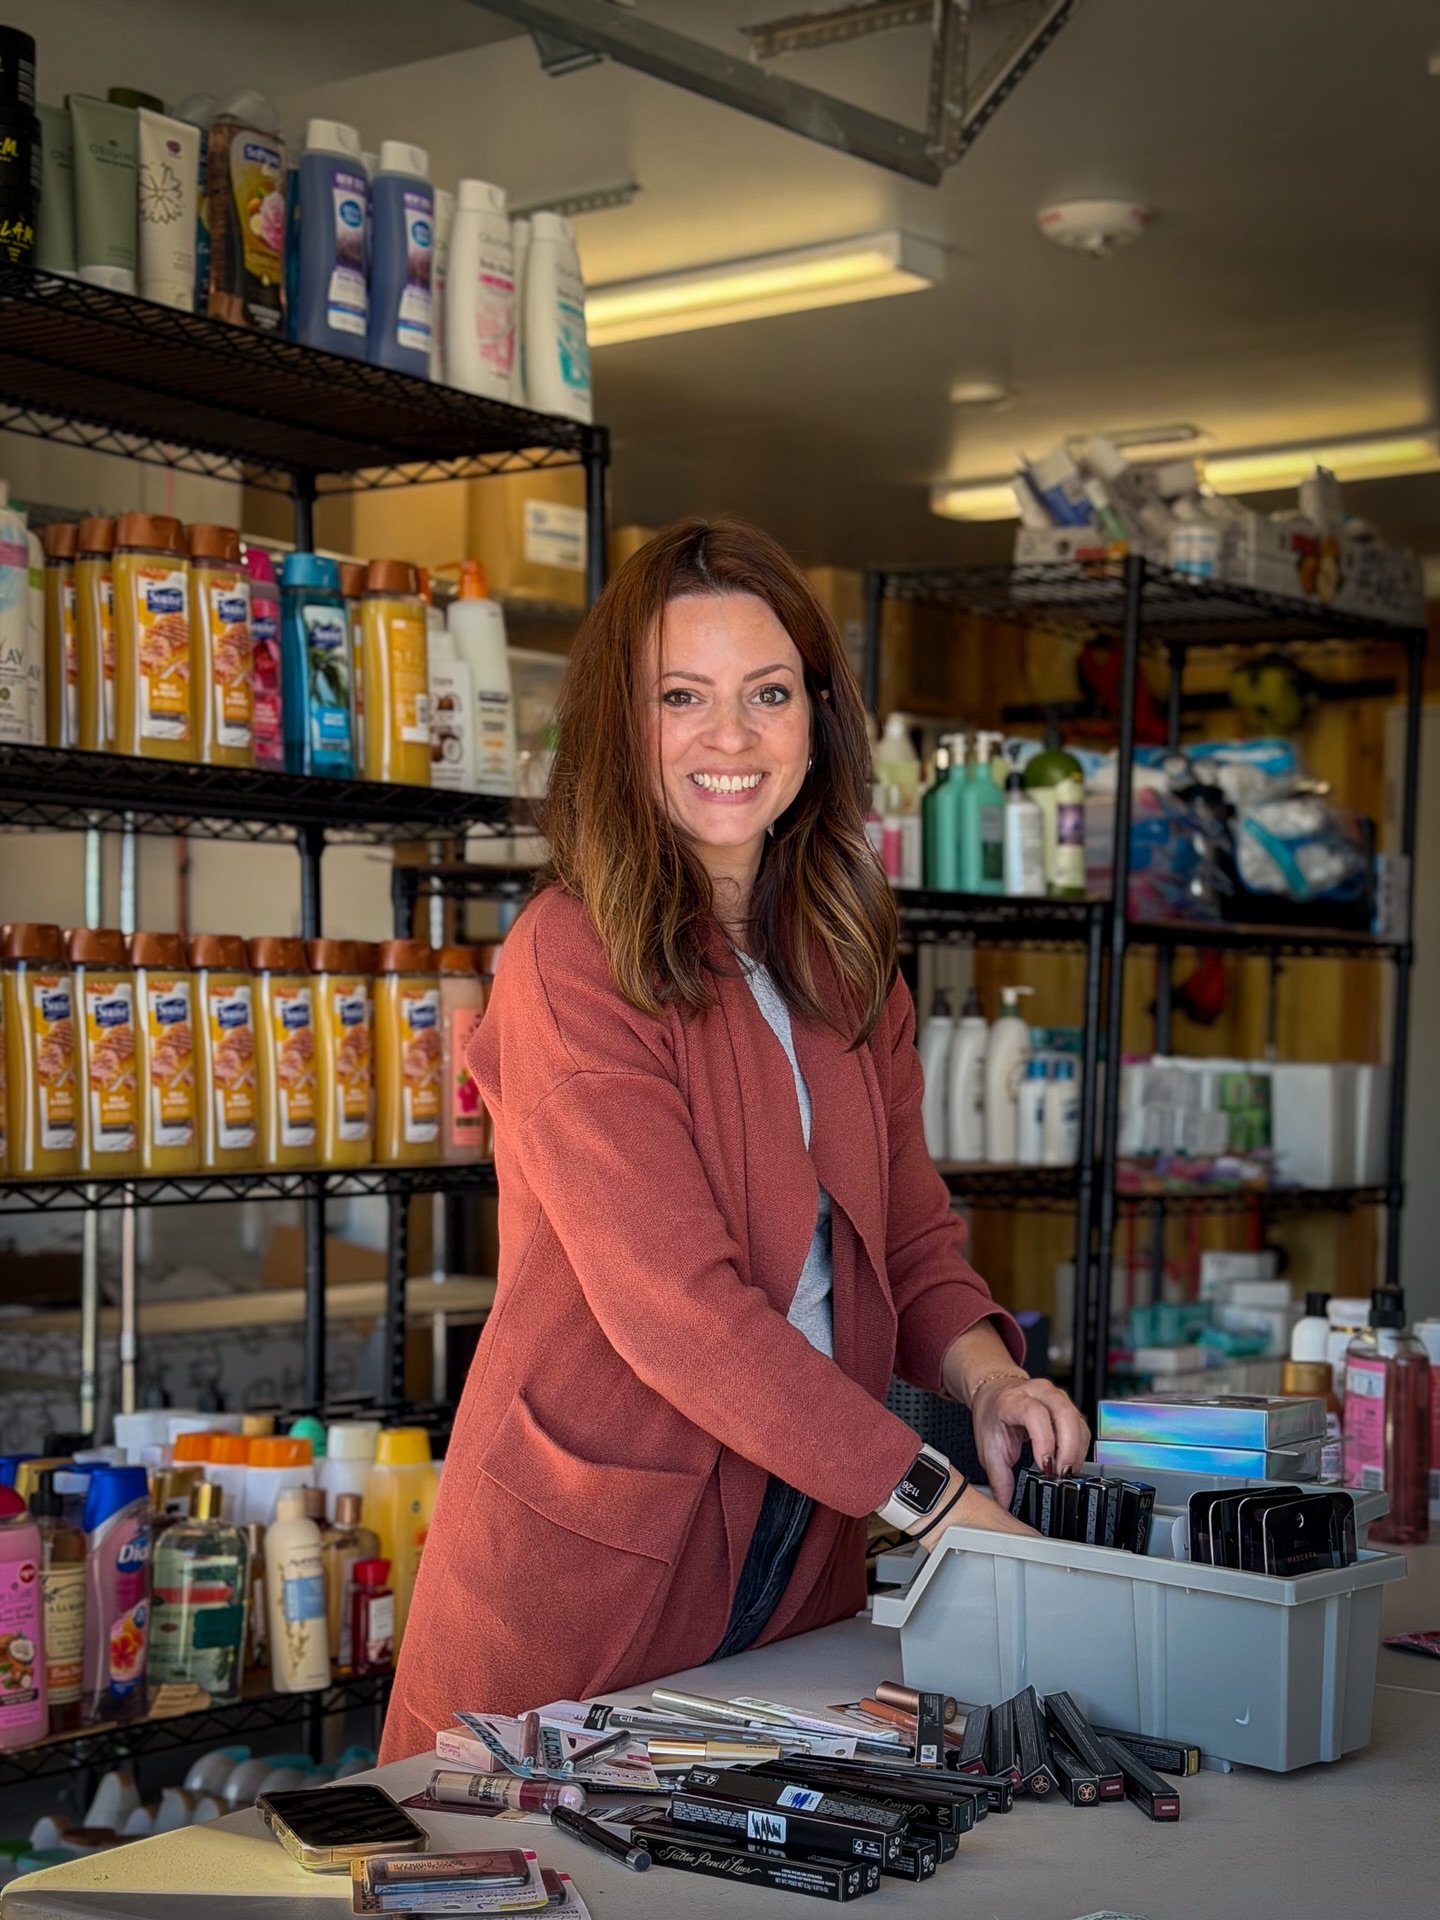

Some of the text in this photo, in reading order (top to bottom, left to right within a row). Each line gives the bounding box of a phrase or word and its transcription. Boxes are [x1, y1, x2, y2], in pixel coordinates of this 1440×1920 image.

[117, 1544, 149, 1564] Dia
[1287, 1551, 1318, 1563] MASCARA
[655, 1845, 762, 1876] Tattoo Pencil Liner
